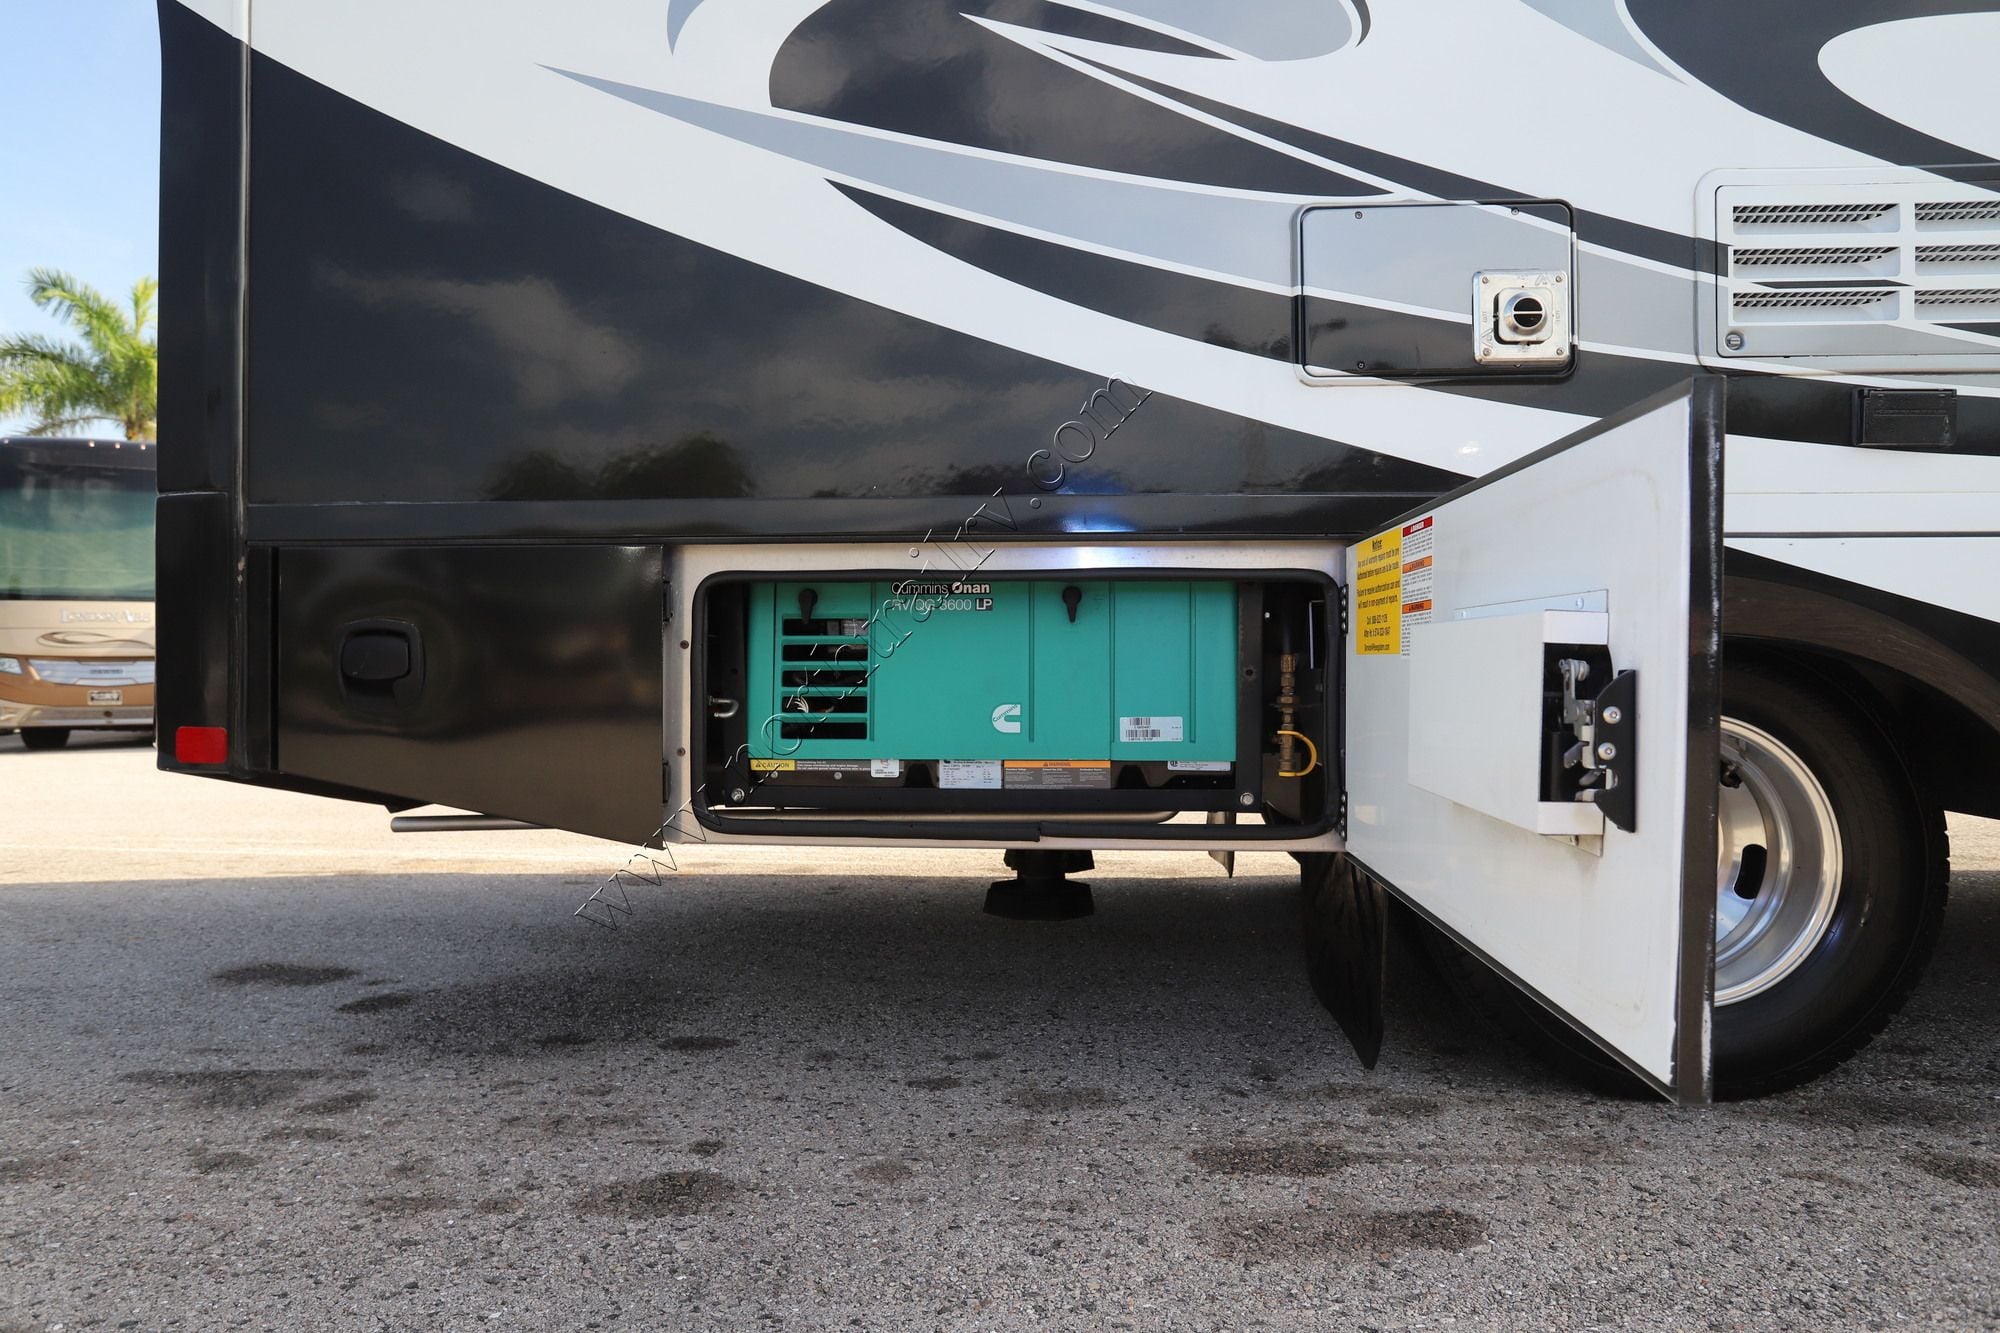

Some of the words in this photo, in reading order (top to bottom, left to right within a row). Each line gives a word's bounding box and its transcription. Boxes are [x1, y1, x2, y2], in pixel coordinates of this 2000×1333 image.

[891, 581, 949, 594] Cummins
[952, 581, 990, 594] Onan
[940, 599, 972, 611] 3600
[976, 599, 993, 610] LP
